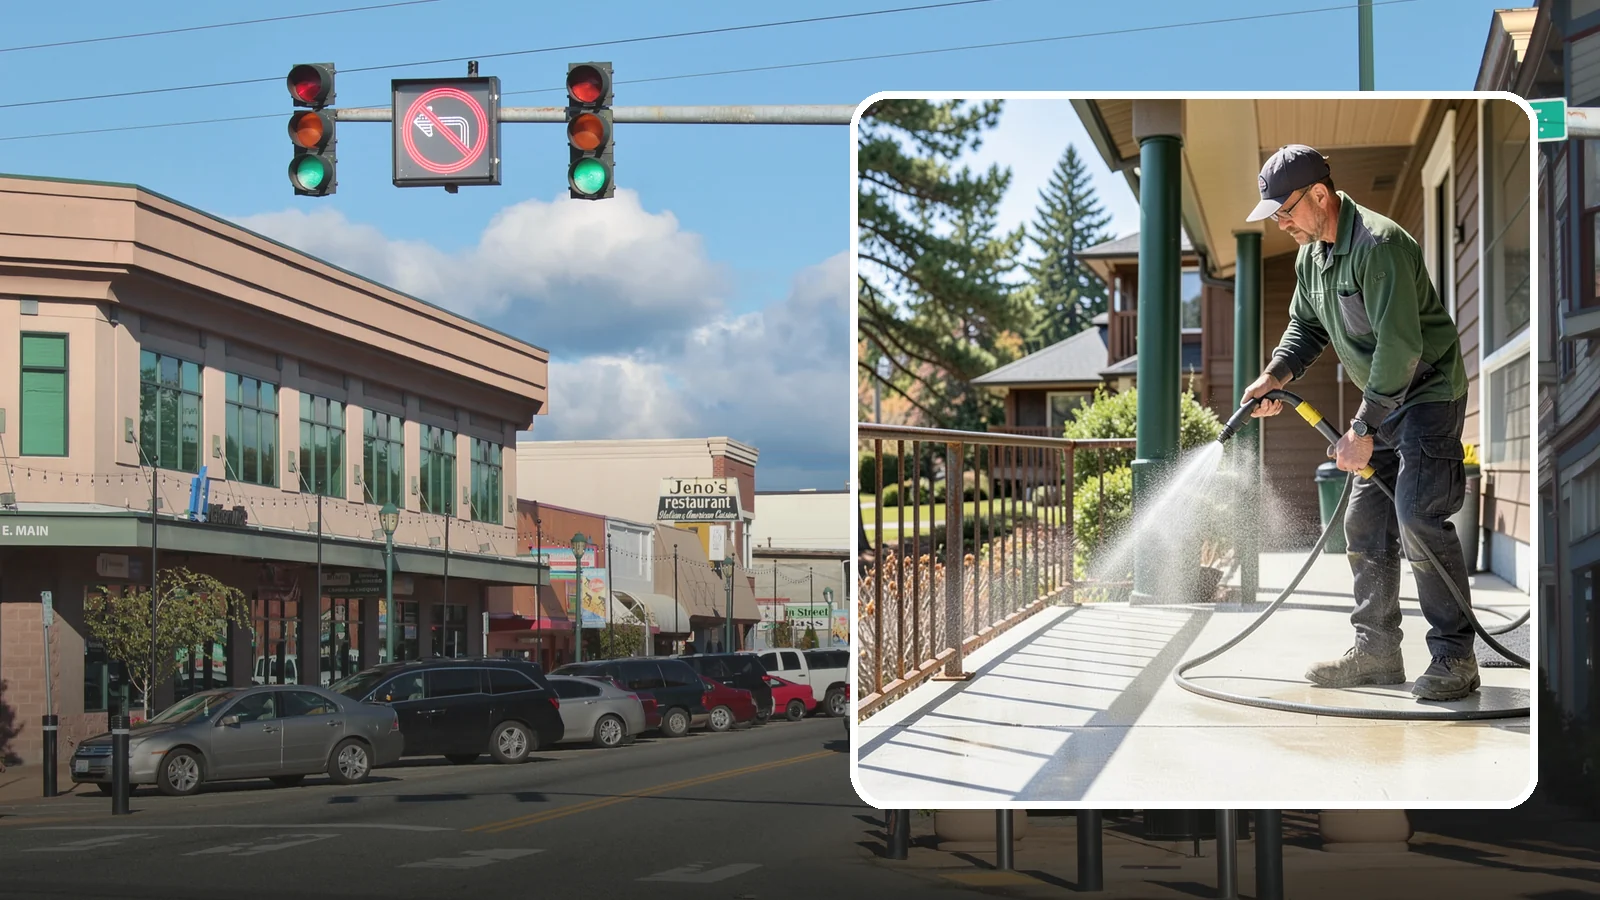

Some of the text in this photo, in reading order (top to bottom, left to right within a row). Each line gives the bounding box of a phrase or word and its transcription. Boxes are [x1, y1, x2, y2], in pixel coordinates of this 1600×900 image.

[670, 480, 727, 494] Jeno's
[665, 496, 731, 509] restaurant
[659, 510, 681, 520] Italian
[686, 510, 714, 519] American
[715, 510, 737, 519] Cuisine
[2, 525, 49, 536] E. MAIN
[797, 607, 828, 617] Street
